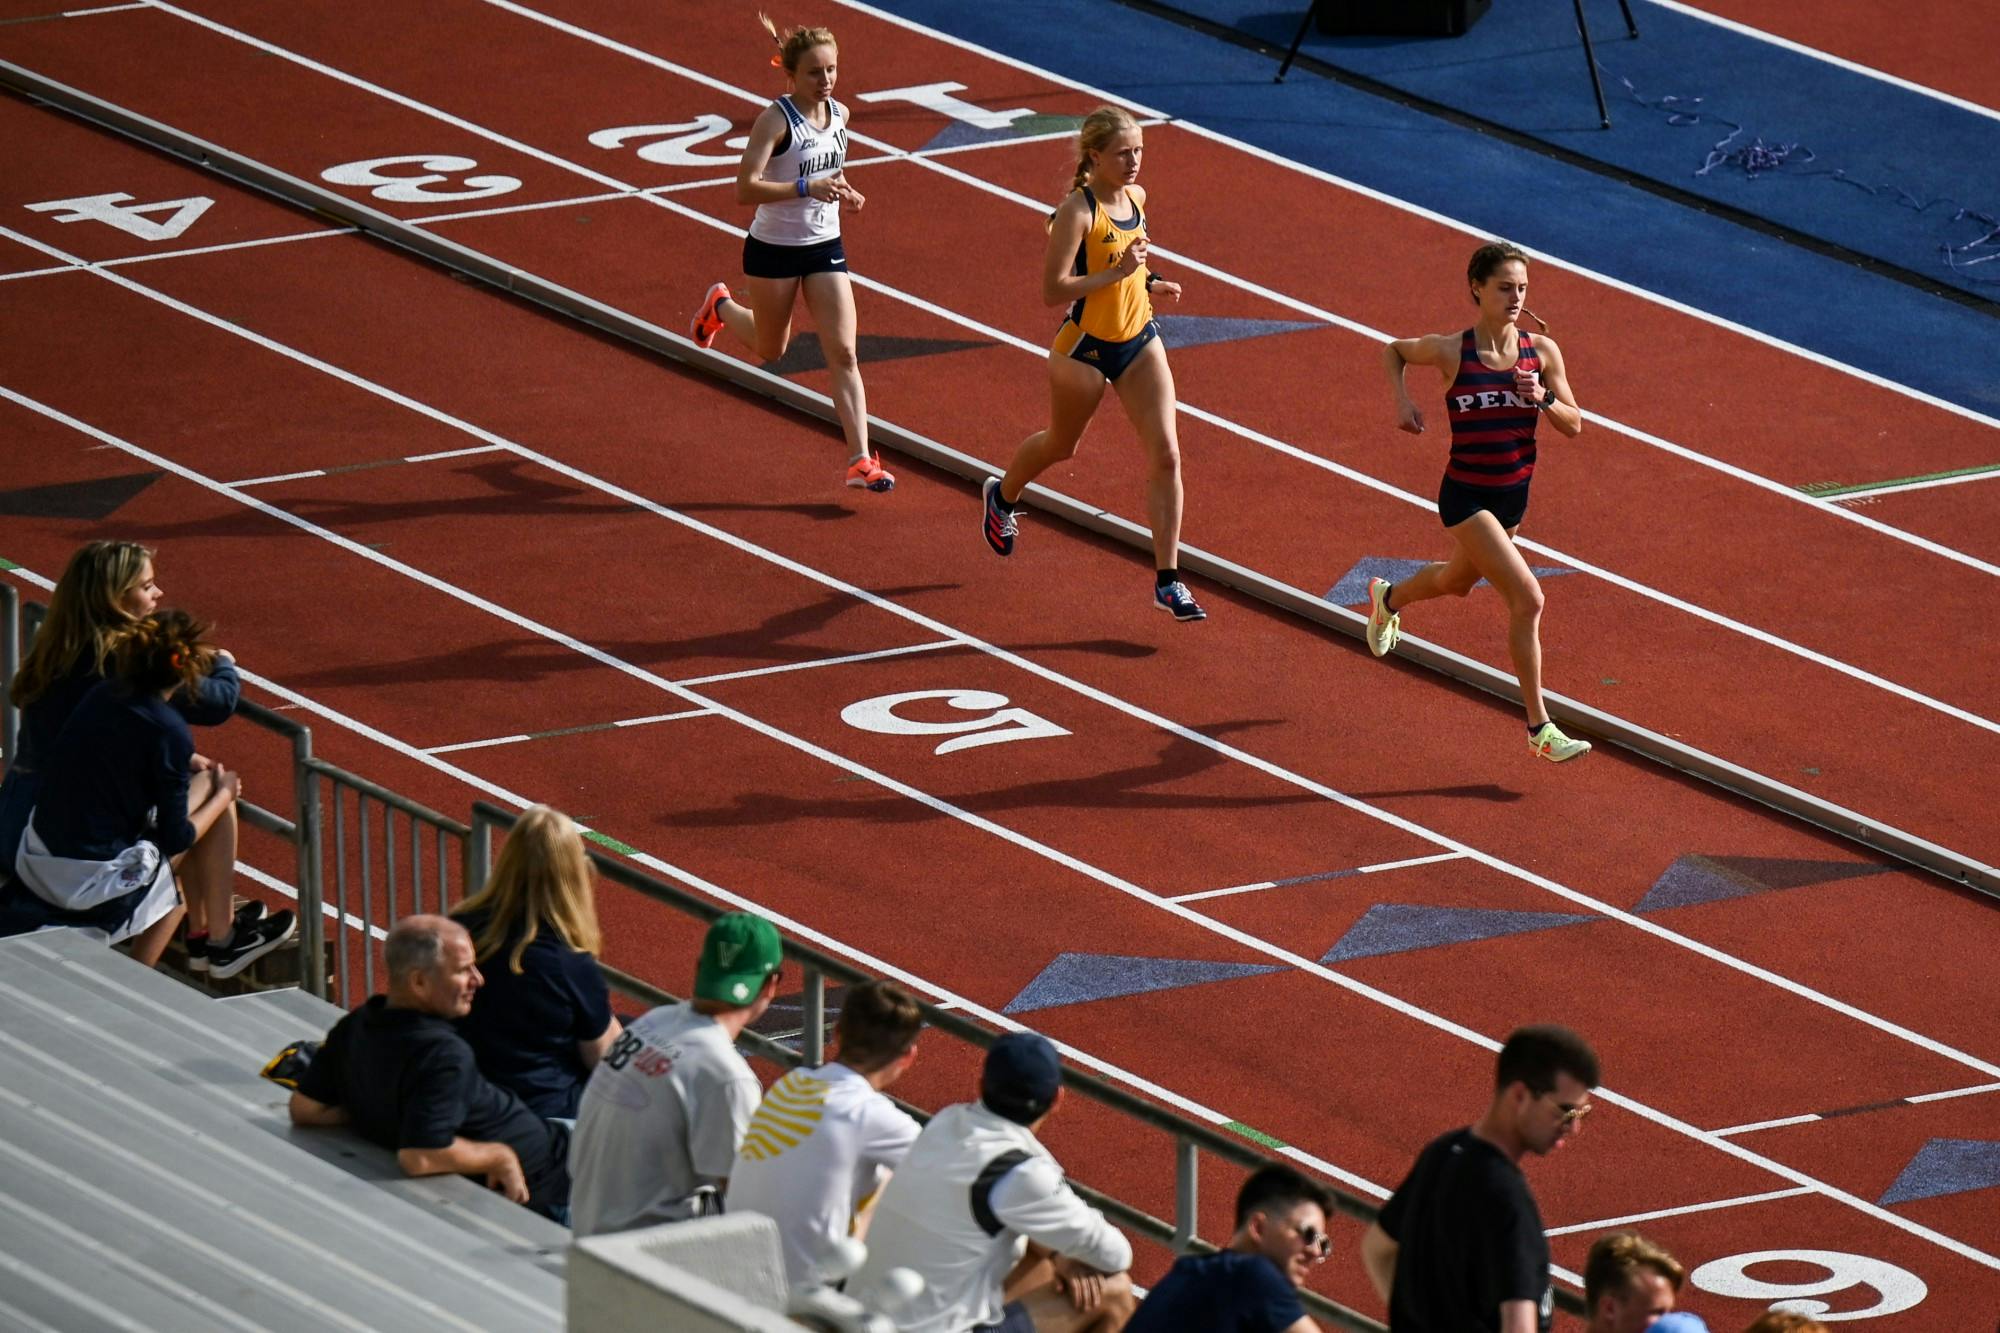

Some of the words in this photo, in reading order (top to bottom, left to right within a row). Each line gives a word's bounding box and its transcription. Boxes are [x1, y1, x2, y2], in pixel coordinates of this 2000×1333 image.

[856, 81, 1038, 129] 1
[588, 114, 752, 166] 2
[321, 155, 522, 202] 3
[24, 192, 215, 241] 4
[1456, 391, 1537, 413] PEN
[839, 689, 1073, 755] 5
[1690, 1250, 1928, 1321] 6
